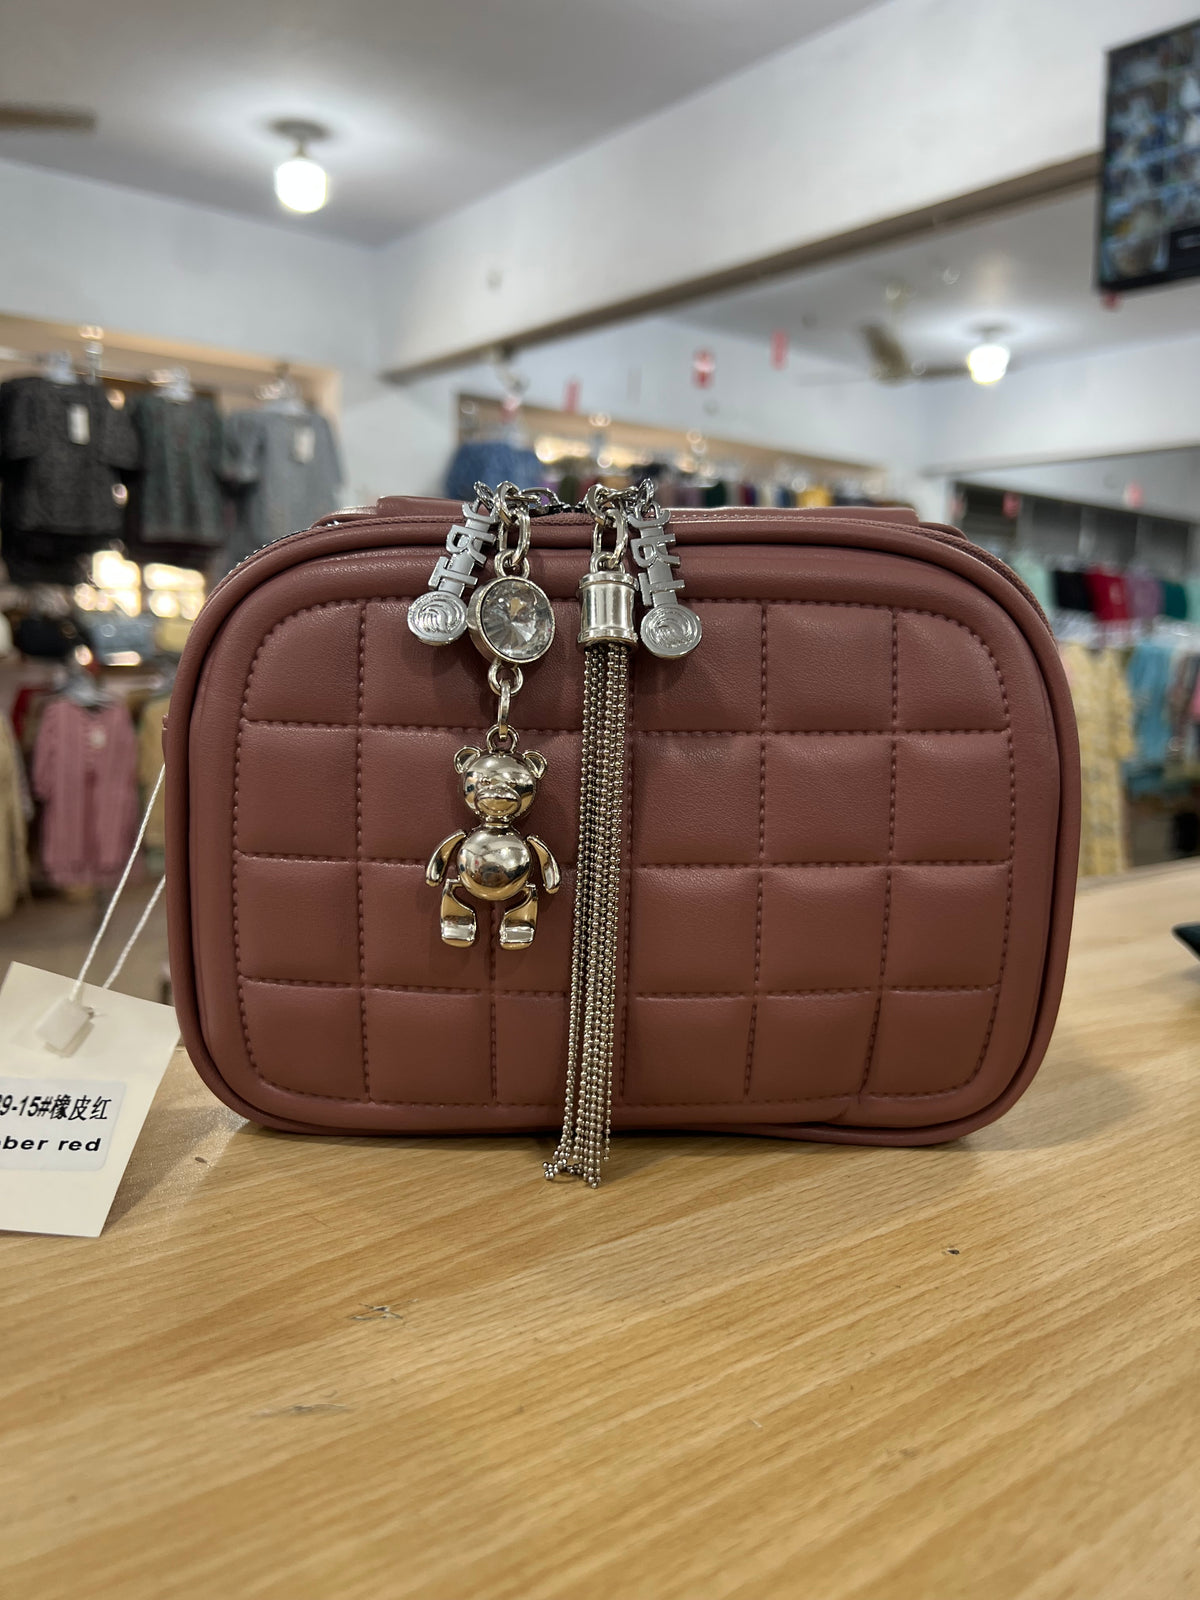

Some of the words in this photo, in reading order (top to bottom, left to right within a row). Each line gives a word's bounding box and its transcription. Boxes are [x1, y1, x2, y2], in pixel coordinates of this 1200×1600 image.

[0, 1094, 112, 1121] 9-15#橡皮红
[0, 1136, 49, 1150] ber
[58, 1138, 102, 1152] red
